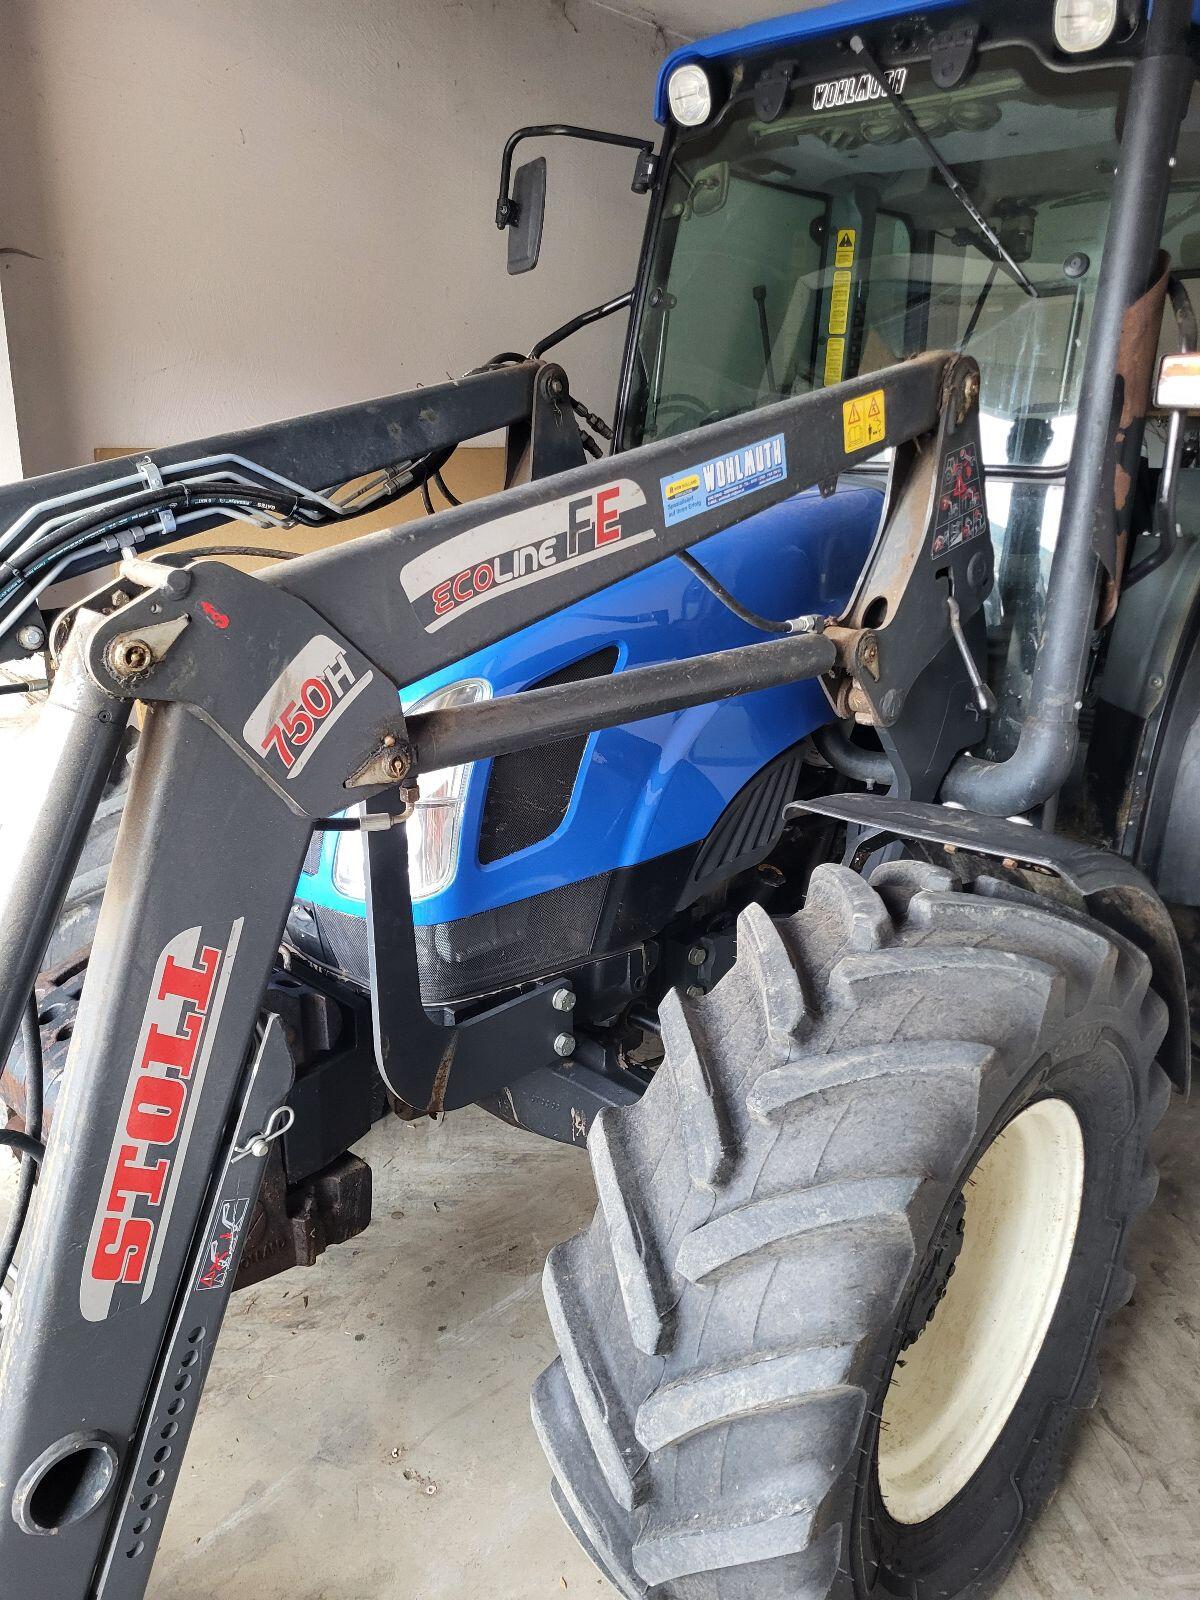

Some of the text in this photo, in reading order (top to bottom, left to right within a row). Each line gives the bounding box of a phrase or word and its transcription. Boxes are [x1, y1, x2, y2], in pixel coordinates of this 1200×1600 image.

[702, 438, 782, 493] WOHLMUTH
[567, 486, 622, 559] FE
[260, 651, 356, 770] 750H
[91, 944, 222, 1285] STOLL
